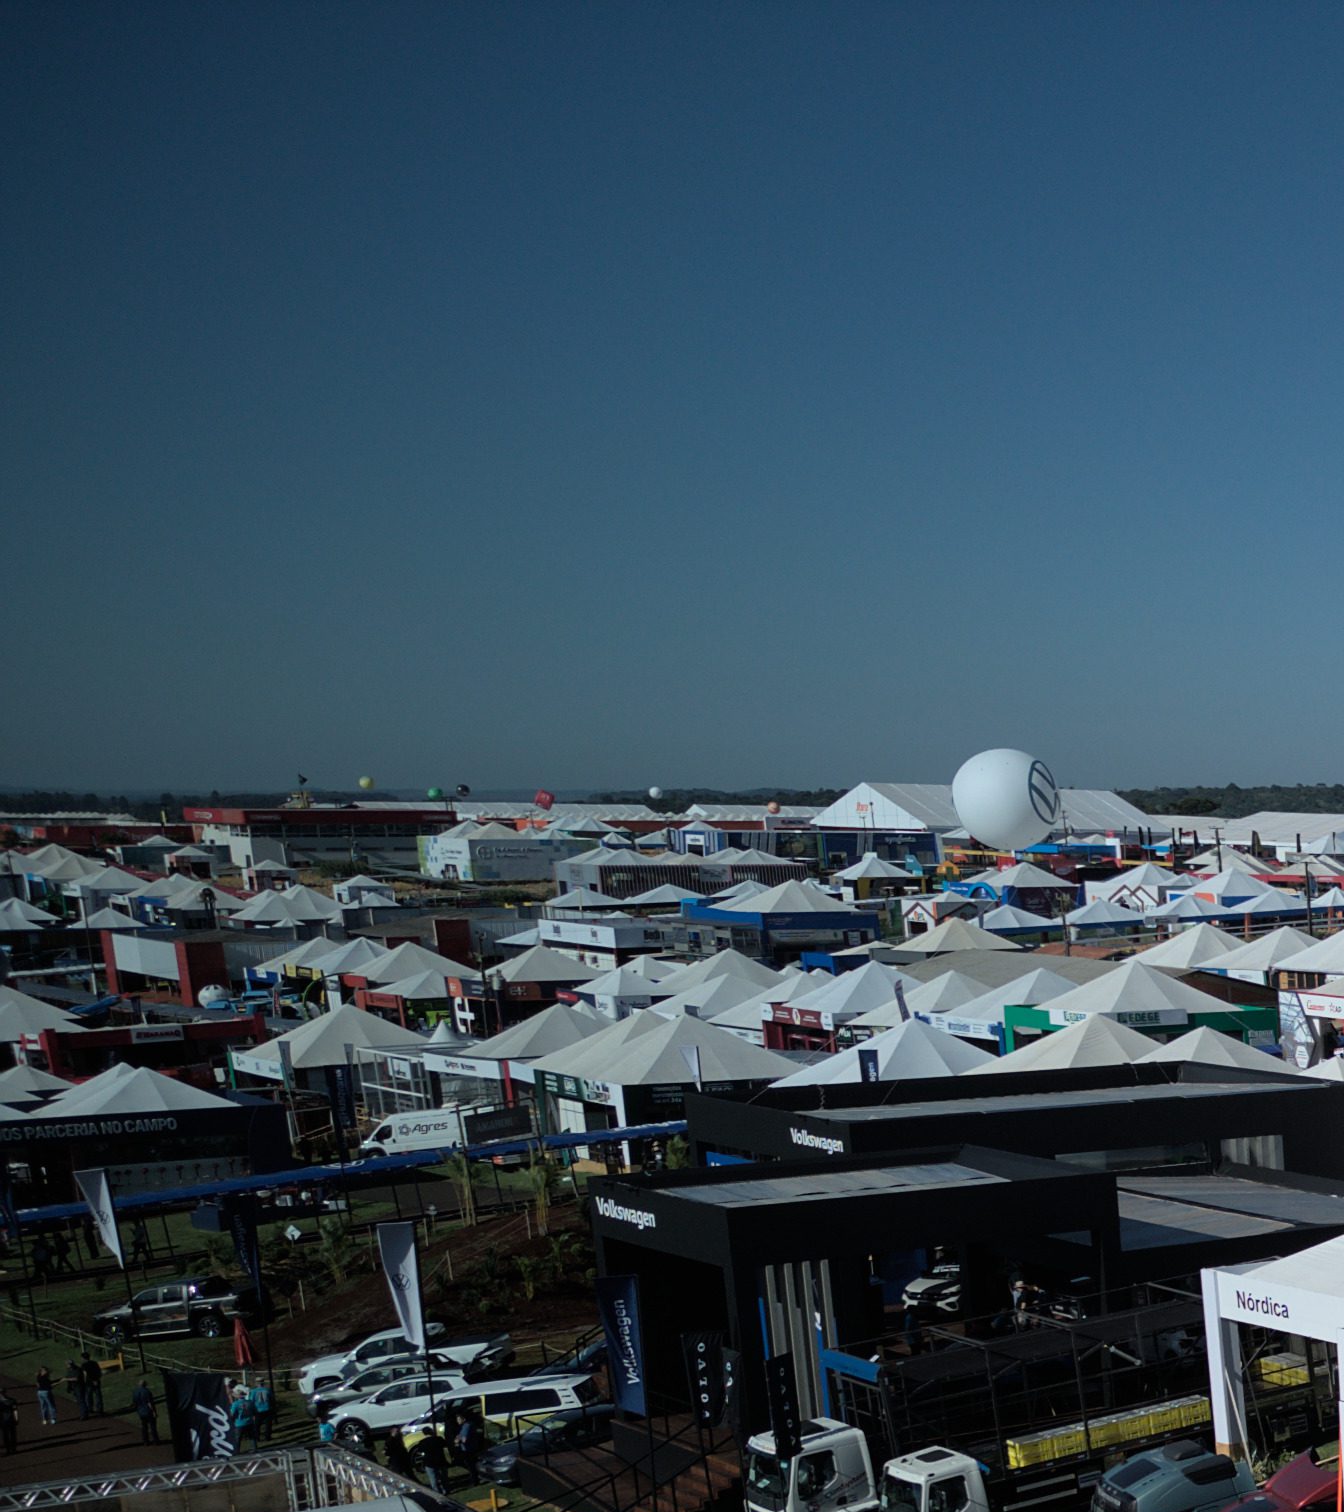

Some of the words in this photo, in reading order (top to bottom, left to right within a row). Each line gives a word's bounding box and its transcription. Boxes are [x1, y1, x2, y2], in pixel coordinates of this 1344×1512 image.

[24, 1121, 98, 1140] PARCERIA
[101, 1119, 122, 1134] NO
[125, 1116, 178, 1134] CAMPO
[412, 1121, 449, 1135] Agres
[790, 1127, 844, 1155] Volkswagen
[594, 1195, 657, 1230] Volkswagen
[1235, 1290, 1290, 1318] Nórdica
[612, 1297, 641, 1386] Volkswagen
[697, 1342, 711, 1421] VOLVO
